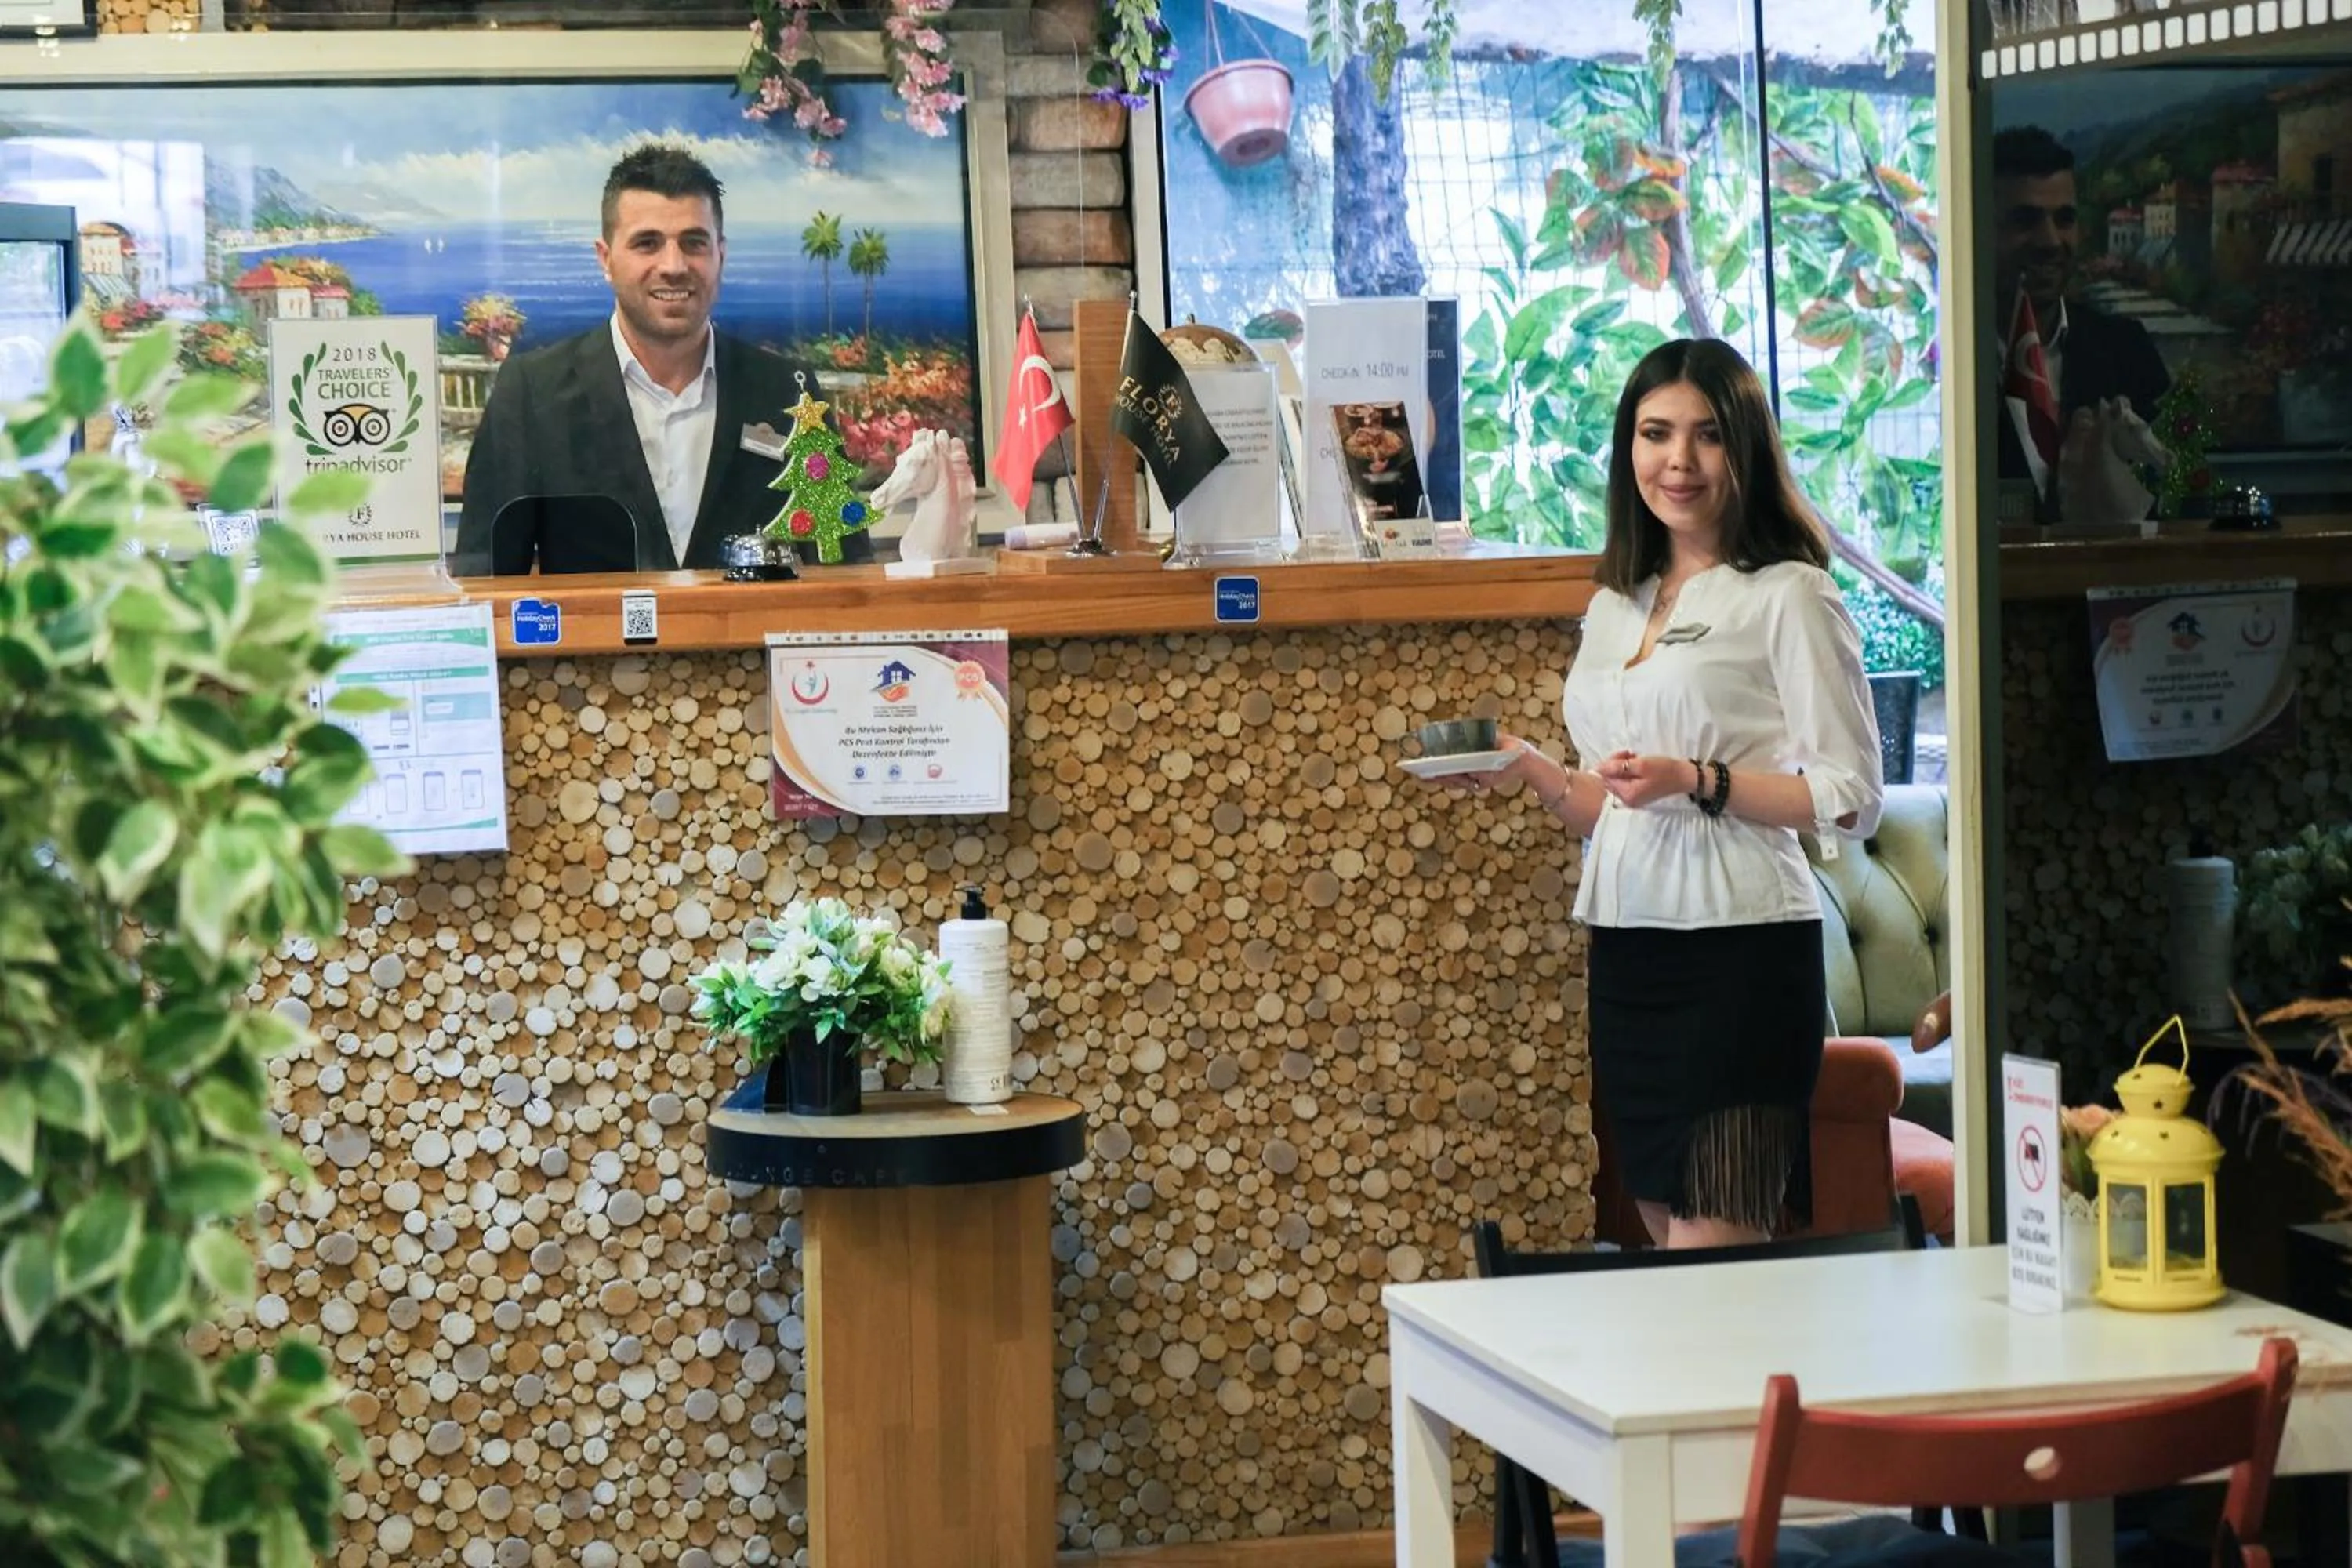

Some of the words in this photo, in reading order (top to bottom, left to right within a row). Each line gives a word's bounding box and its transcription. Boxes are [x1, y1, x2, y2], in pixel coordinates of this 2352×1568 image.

[332, 347, 376, 362] 2018
[1367, 361, 1394, 377] 14:00
[318, 382, 391, 400] CHOICE
[347, 532, 383, 543] HOUSE
[387, 529, 421, 540] HOTEL
[539, 623, 556, 632] 2017
